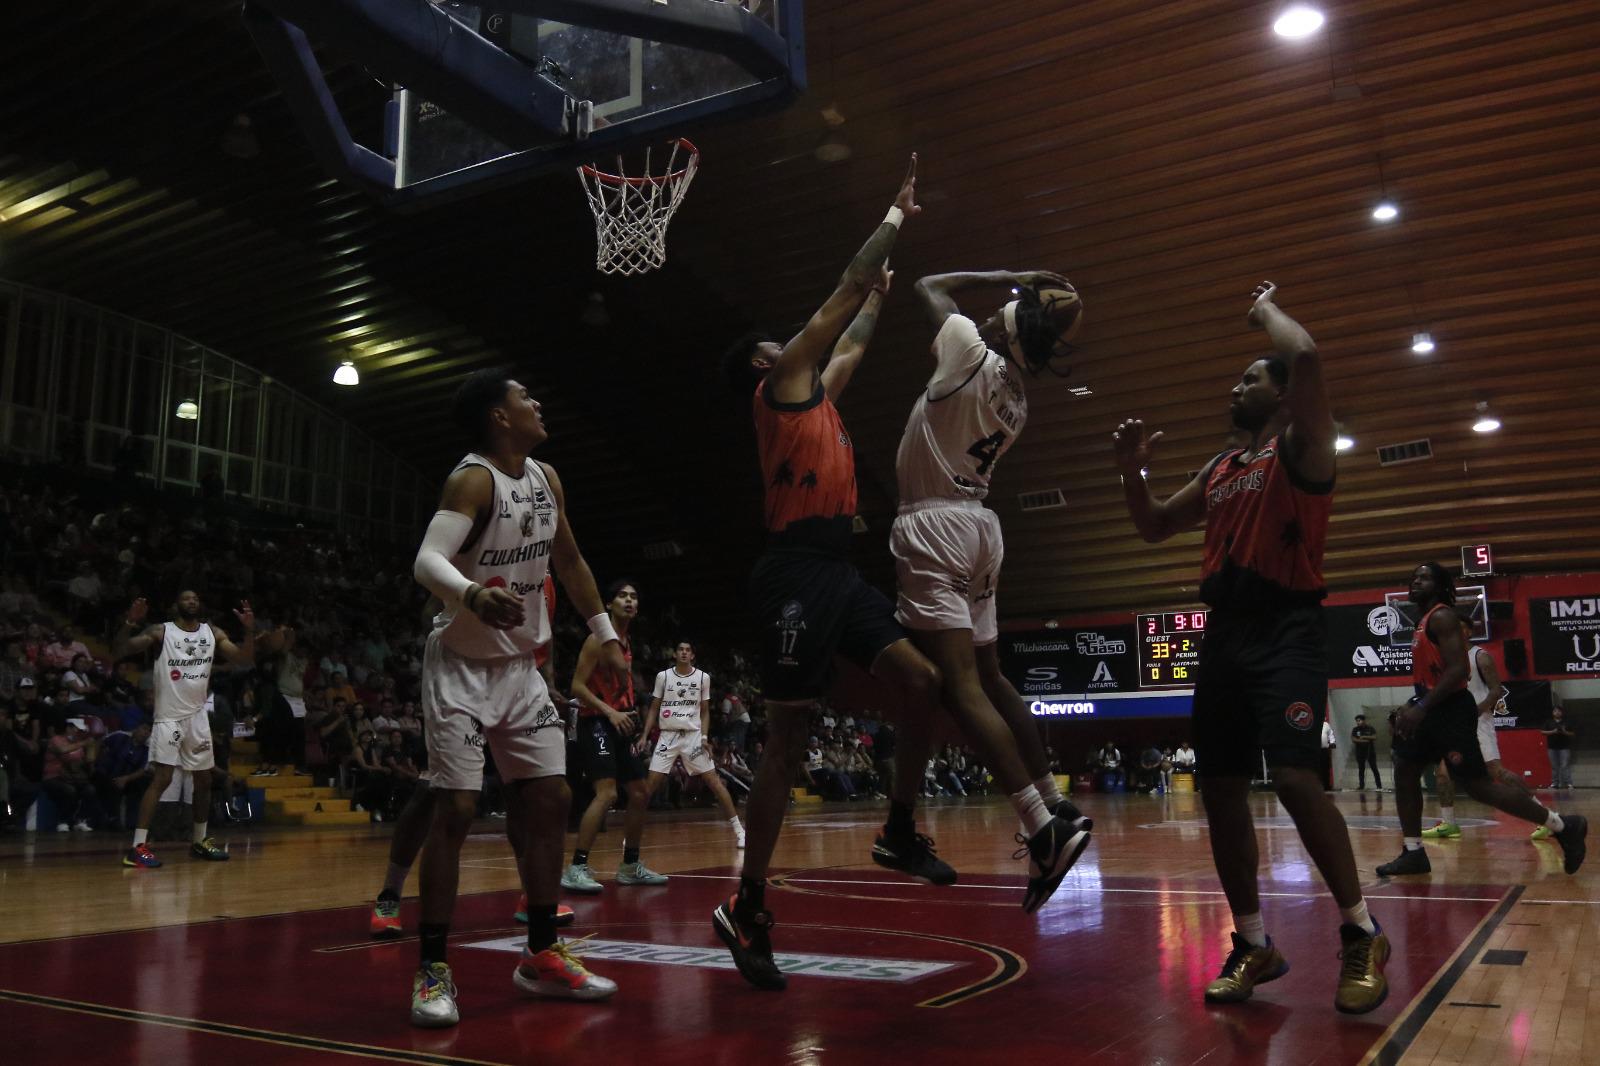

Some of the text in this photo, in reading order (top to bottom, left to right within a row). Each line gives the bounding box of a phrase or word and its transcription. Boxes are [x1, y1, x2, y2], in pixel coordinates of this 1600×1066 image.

[967, 430, 1007, 475] 4
[1476, 547, 1489, 565] 5
[1549, 598, 1600, 618] IMJ
[1148, 623, 1156, 634] 2
[1174, 613, 1204, 630] 9:10
[781, 630, 798, 654] 17
[1145, 635, 1171, 643] GUEST
[1012, 642, 1070, 653] Michoacana
[1151, 640, 1190, 659] 33 2
[1383, 658, 1413, 666] Privada
[1151, 667, 1187, 680] 0 06
[1024, 682, 1062, 691] SoniGas
[1030, 701, 1094, 716] Chevron
[314, 802, 324, 812] A
